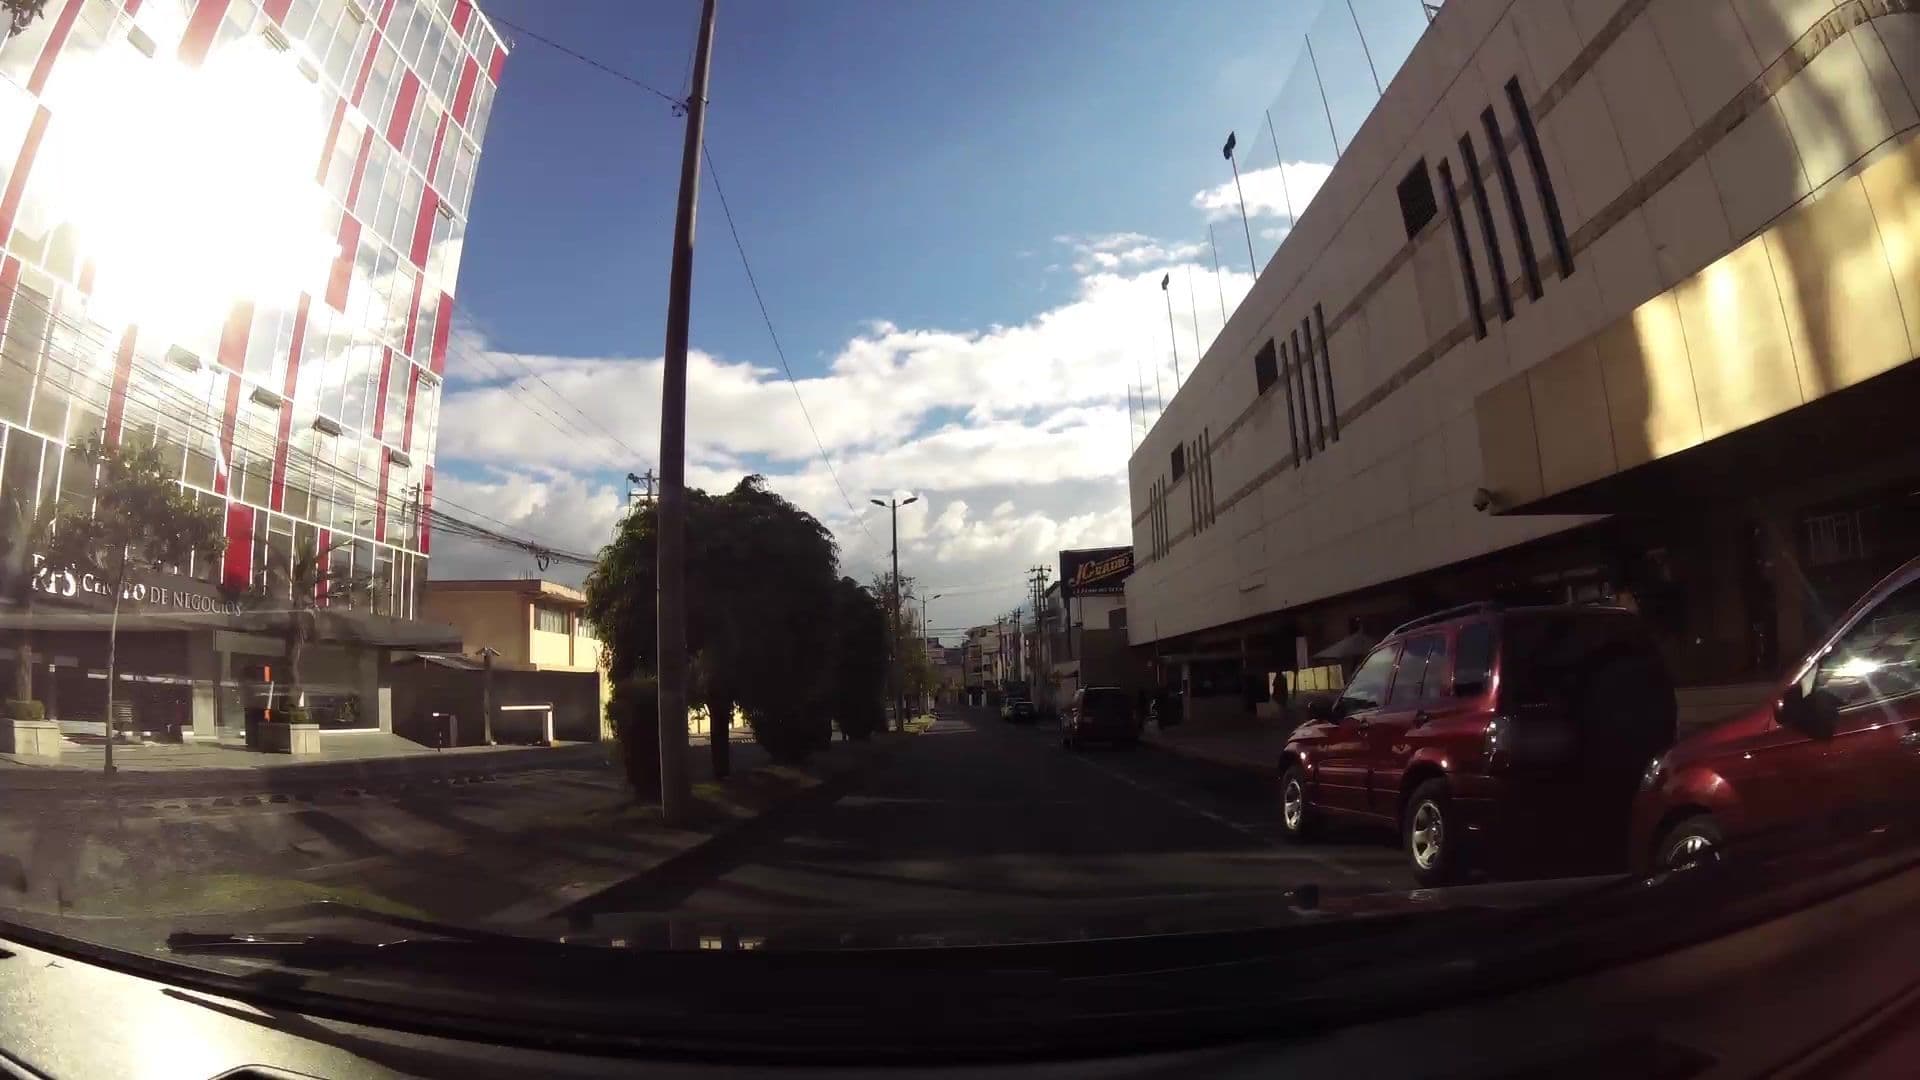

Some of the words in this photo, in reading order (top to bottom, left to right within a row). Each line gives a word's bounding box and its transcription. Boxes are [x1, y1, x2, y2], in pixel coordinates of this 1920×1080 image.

[82, 573, 146, 601] CENO
[150, 586, 168, 605] DE
[173, 591, 241, 617] NEGOCIOS
